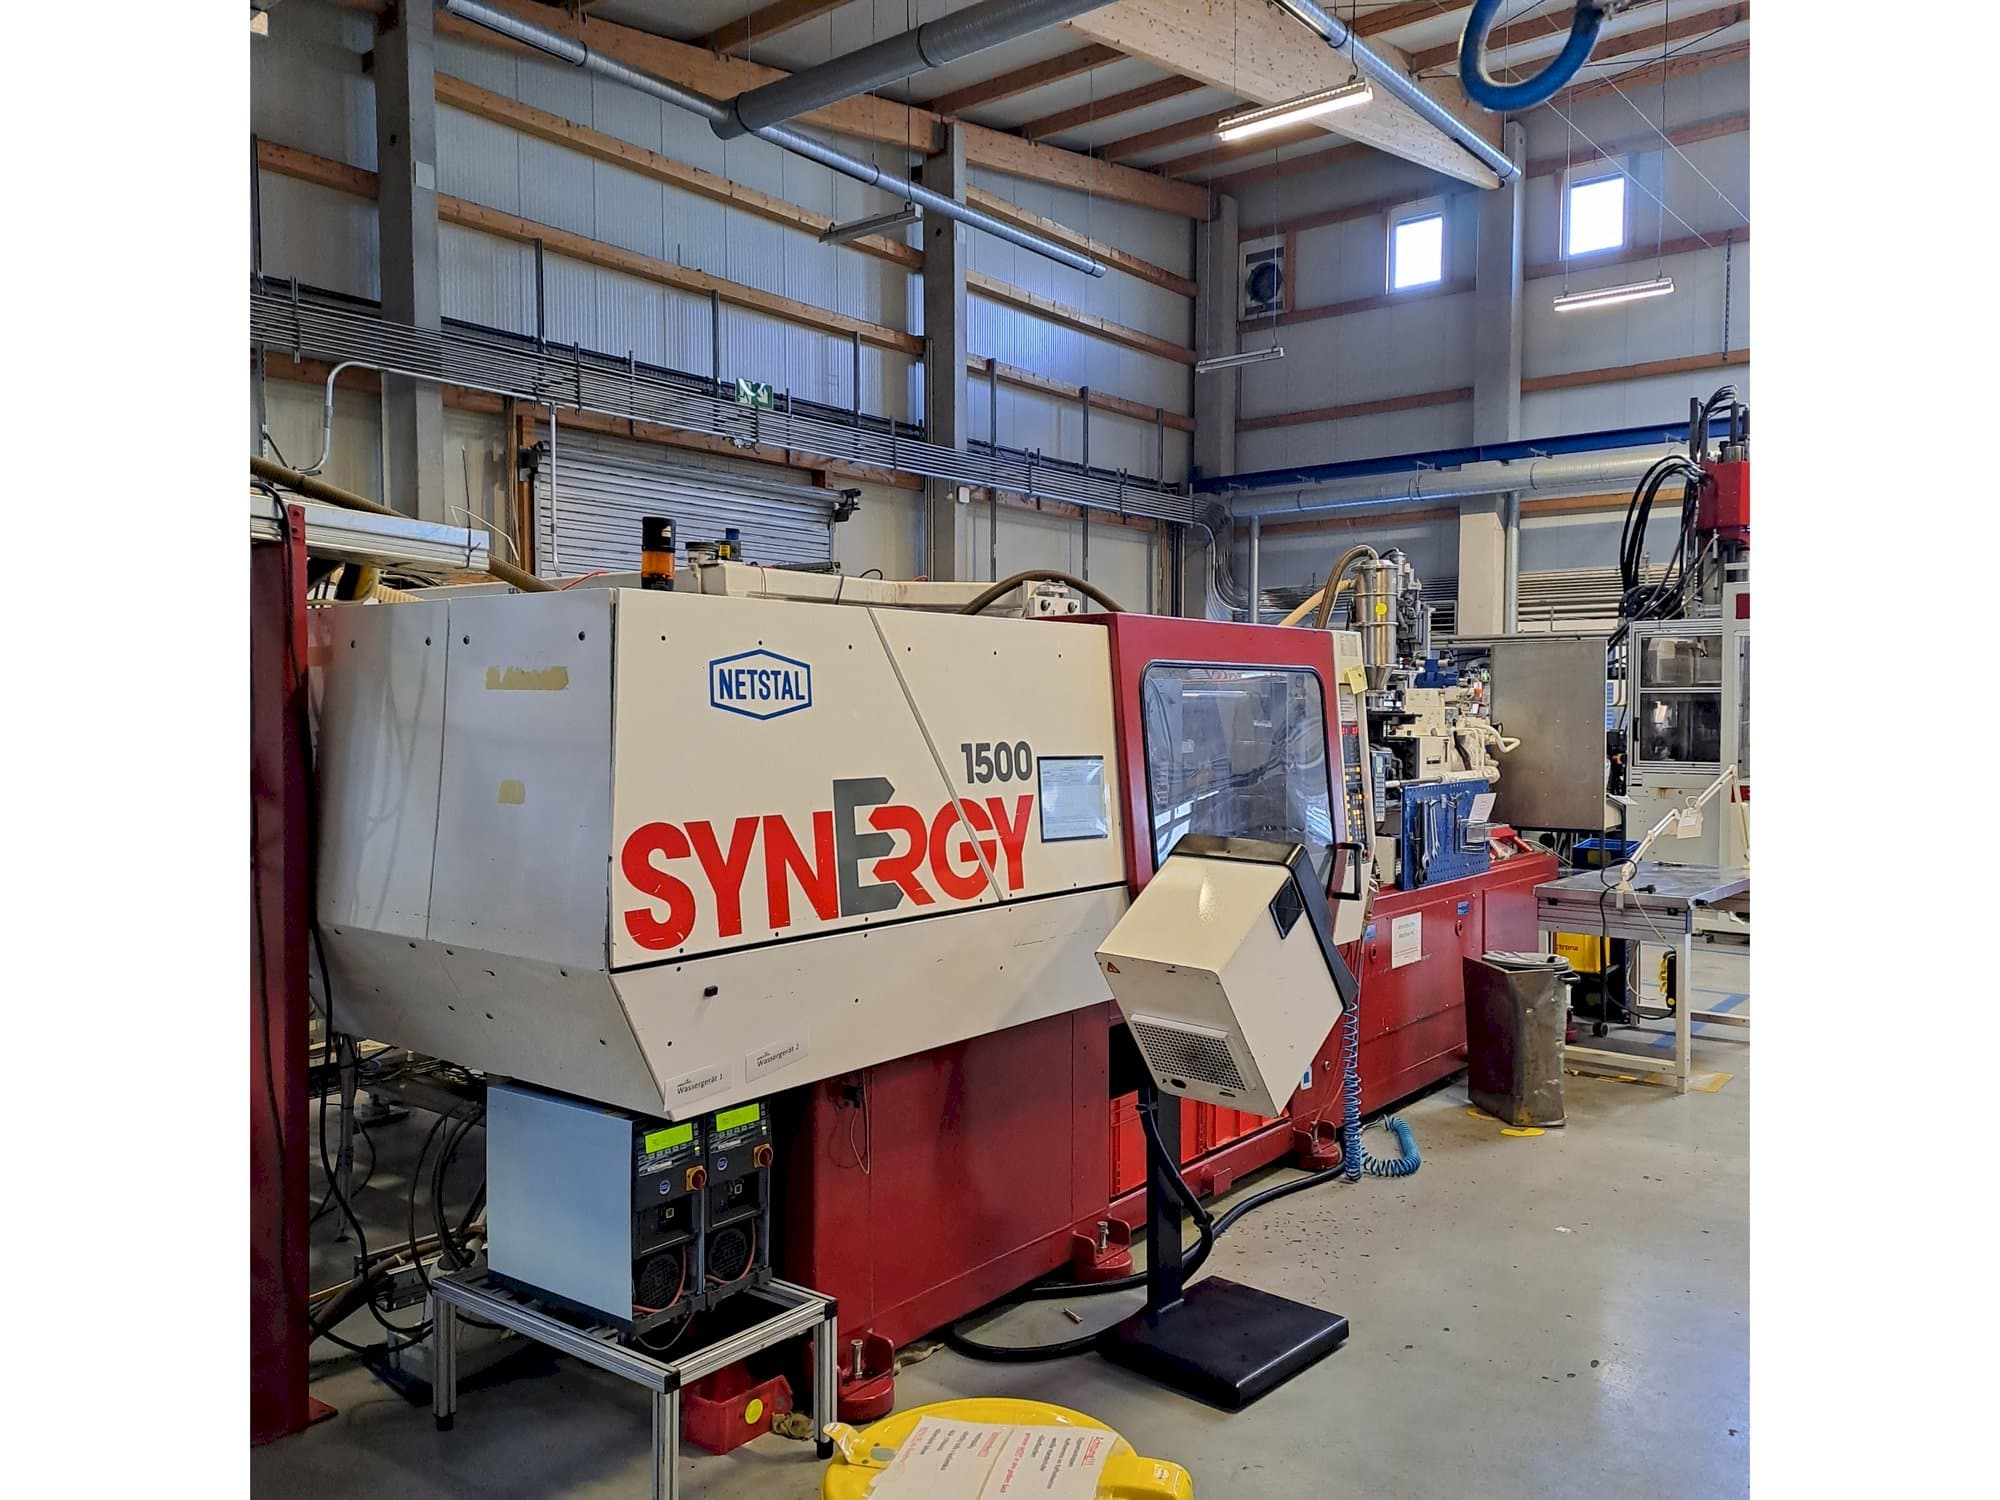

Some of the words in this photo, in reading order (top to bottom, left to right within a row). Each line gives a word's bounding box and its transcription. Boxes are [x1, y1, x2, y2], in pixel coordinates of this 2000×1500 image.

[719, 668, 806, 700] NETSTAL
[960, 741, 1032, 784] 1500
[621, 776, 1034, 950] SYNERGY
[677, 1074, 718, 1094] Wassergerät
